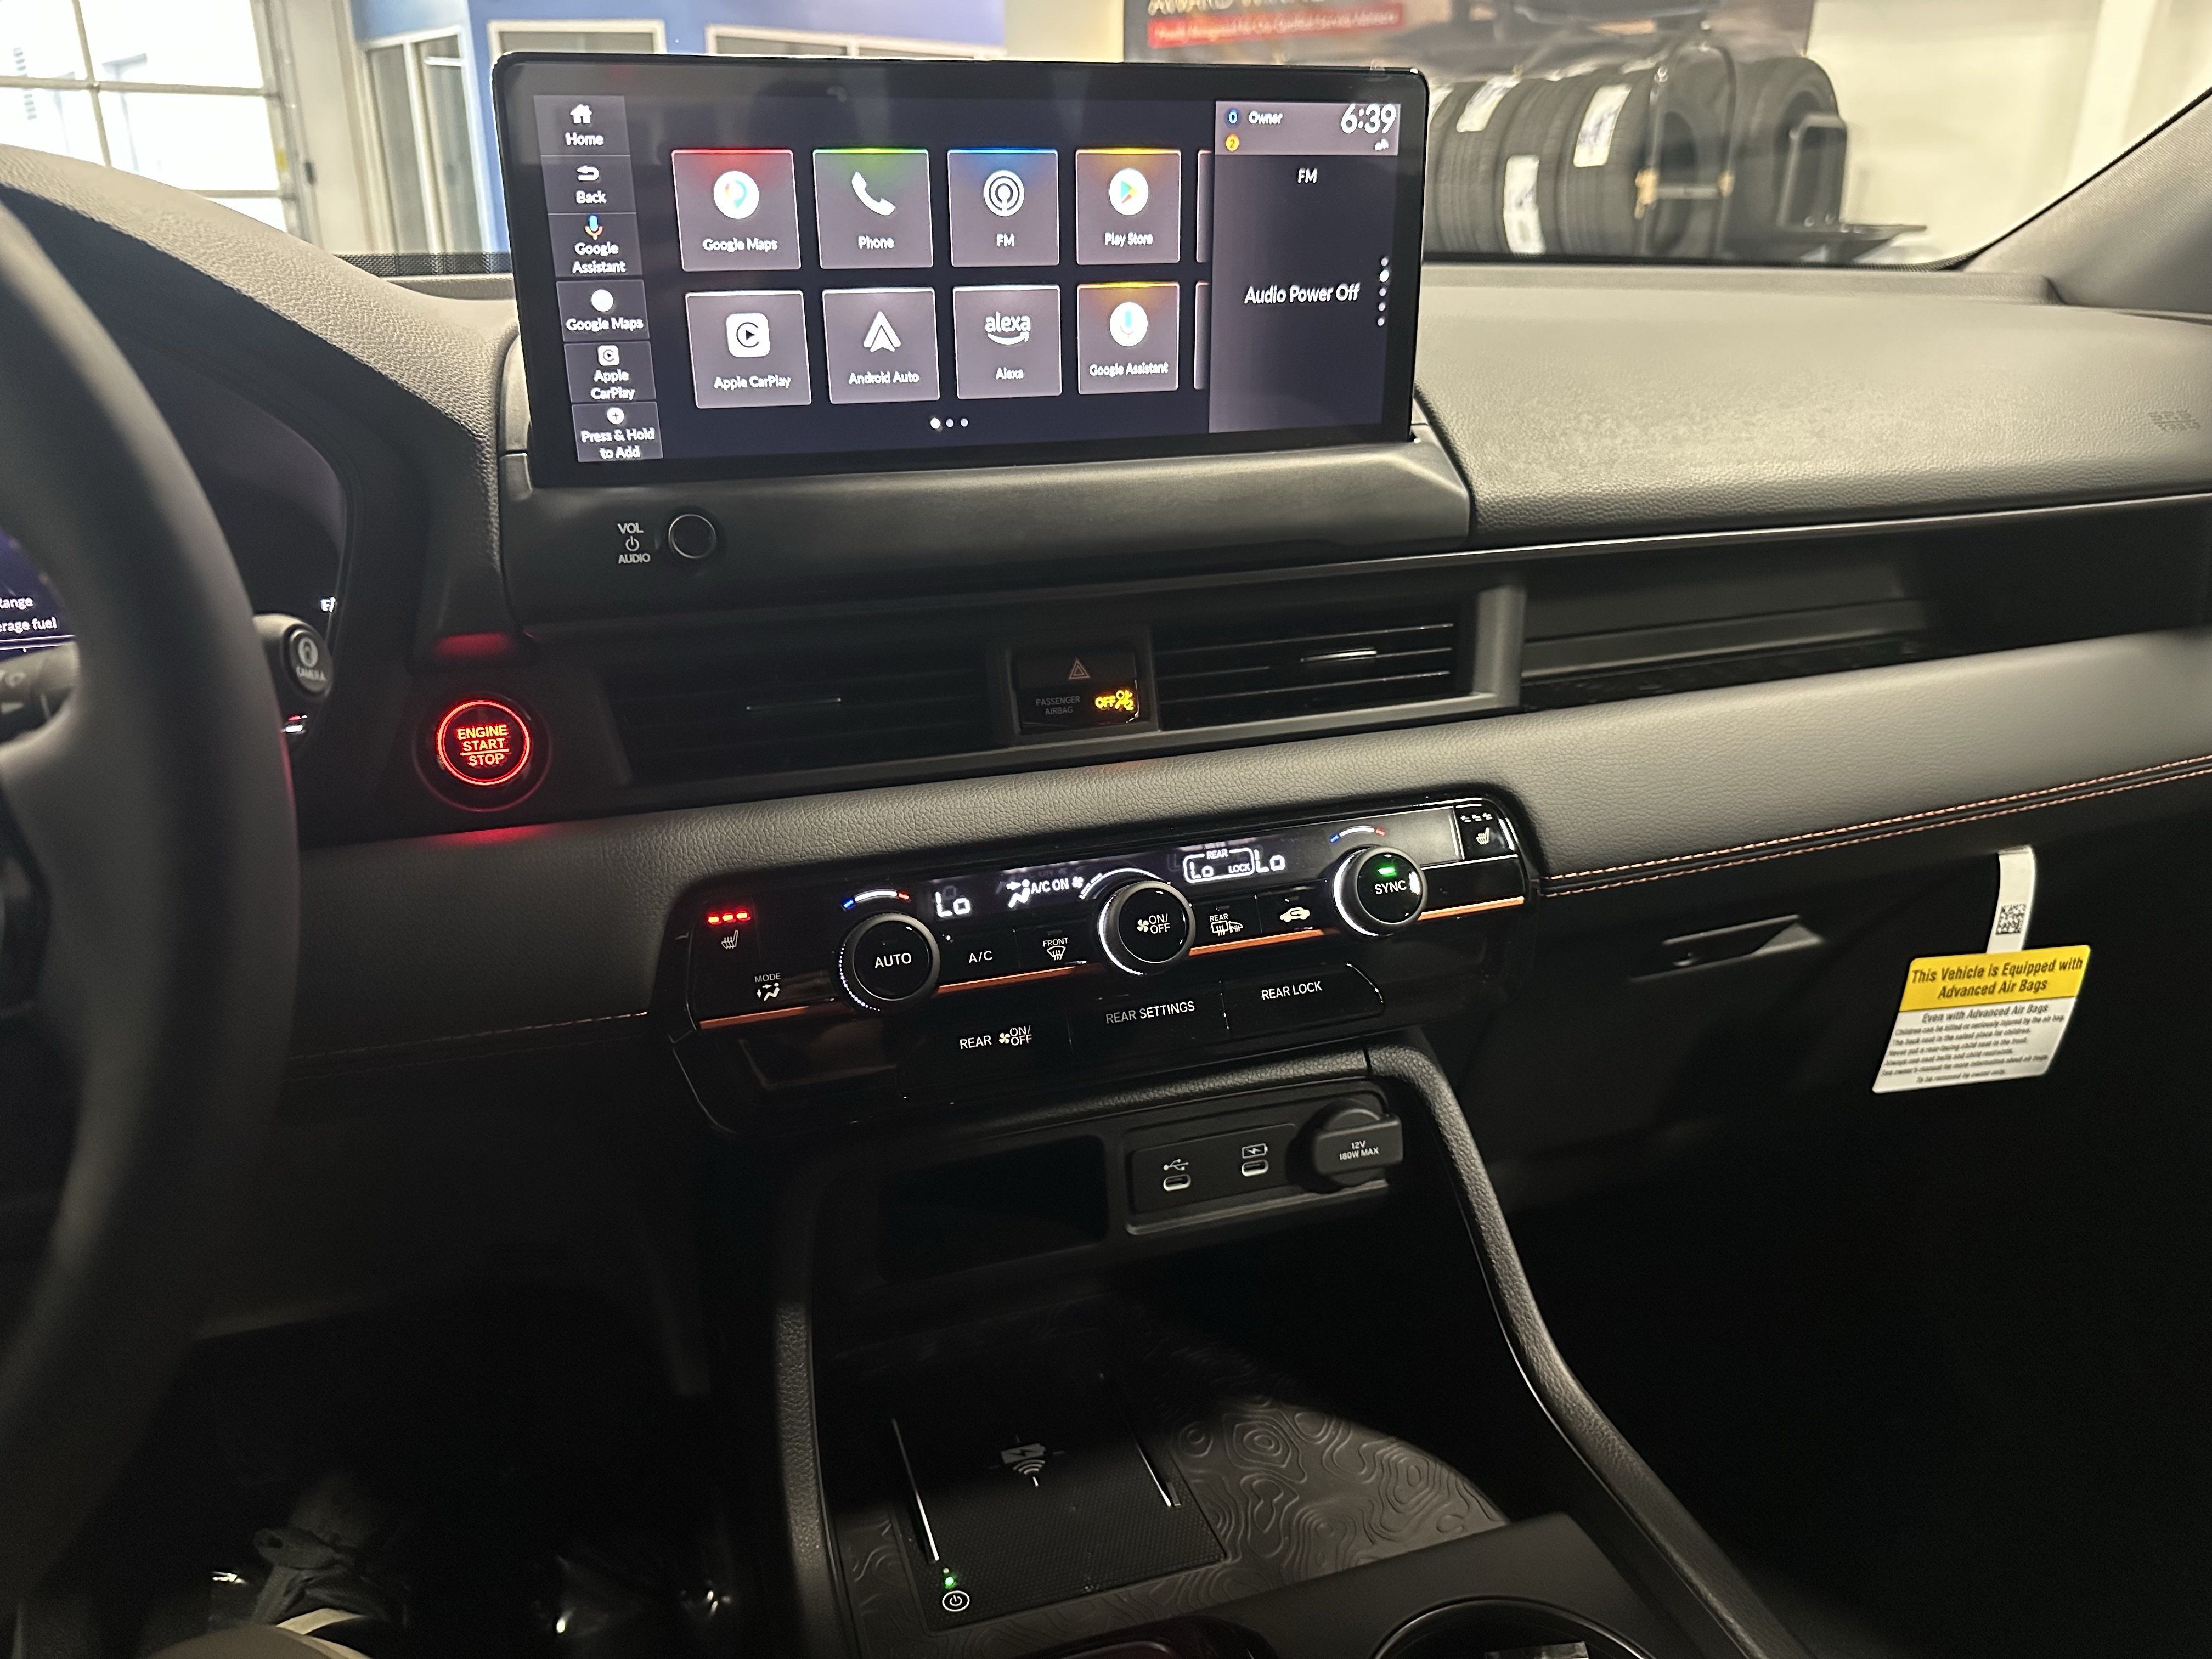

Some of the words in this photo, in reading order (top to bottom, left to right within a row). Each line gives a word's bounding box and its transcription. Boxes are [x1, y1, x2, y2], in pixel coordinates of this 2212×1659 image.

[1249, 111, 1283, 125] Owner
[1341, 103, 1397, 133] 6:39
[565, 132, 604, 145] Home
[1298, 168, 1317, 183] FM
[576, 190, 607, 204] Back
[703, 238, 744, 252] Google
[747, 237, 778, 251] Maps
[858, 235, 894, 249] Phone
[997, 233, 1015, 247] FM
[1105, 232, 1126, 247] Play
[1127, 232, 1153, 245] Store
[575, 242, 618, 256] Google
[572, 261, 627, 274] Assistant
[1244, 286, 1286, 304] Audio
[1289, 285, 1334, 303] Power
[1336, 283, 1361, 301] Off
[566, 317, 609, 332] Google
[612, 317, 644, 331] Maps
[985, 311, 1031, 332] alexa
[594, 369, 629, 383] Apple
[995, 367, 1024, 380] Alexa
[1089, 363, 1124, 377] Google
[1126, 362, 1169, 375] Assistant
[714, 376, 748, 390] Apple
[749, 374, 791, 388] CarPlay
[849, 371, 890, 385] Android
[893, 371, 919, 383] Auto
[590, 386, 635, 400] CarPlay
[580, 430, 612, 443] Press
[614, 429, 625, 441] &
[626, 427, 655, 440] Hold
[599, 448, 613, 459] to
[615, 445, 640, 458] Add
[617, 523, 644, 534] VOL
[618, 553, 651, 564] AUDIO
[32, 617, 57, 630] fuel
[1036, 696, 1081, 707] PASSENGER
[1095, 696, 1116, 708] OFF
[1045, 706, 1074, 715] AIRBAG
[457, 725, 508, 740] ENGINE
[463, 738, 505, 752] START
[469, 753, 504, 766] STOP
[1206, 849, 1228, 860] REAR
[1254, 849, 1286, 873] Lo
[1228, 862, 1250, 874] LOCK
[1031, 881, 1051, 895] A/C
[1052, 878, 1069, 891] ON
[1374, 879, 1407, 895] SYNC
[935, 891, 970, 917] Lo
[1149, 913, 1169, 923] ON/
[1209, 913, 1229, 922] REAR
[1150, 923, 1170, 934] OFF
[1043, 938, 1069, 948] FRONT
[874, 952, 912, 968] AUTO
[969, 950, 993, 963] A/C
[1912, 969, 1937, 983] This
[1941, 964, 1984, 981] Vehicle
[1988, 966, 1998, 977] is
[2002, 959, 2056, 978] Equipped
[2059, 957, 2084, 972] with
[754, 973, 781, 983] MODE
[1261, 988, 1291, 1001] REAR
[1293, 980, 1323, 996] LOCK
[1937, 981, 1999, 1000] Advanced
[1999, 980, 2016, 994] Air
[2019, 978, 2048, 993] Bags
[1105, 1009, 1137, 1025] REAR
[1139, 1000, 1195, 1020] SETTINGS
[1922, 1012, 1945, 1023] Even
[1945, 1011, 1965, 1021] with
[1966, 1006, 2011, 1019] Advanced
[2011, 1005, 2026, 1015] Air
[2027, 1004, 2049, 1014] Bags
[1009, 1025, 1031, 1037] ON/
[960, 1035, 992, 1049] REAR
[1011, 1034, 1032, 1046] OFF
[1351, 1141, 1366, 1149] 12V
[1339, 1150, 1359, 1161] 180W
[1361, 1147, 1379, 1156] MAX
